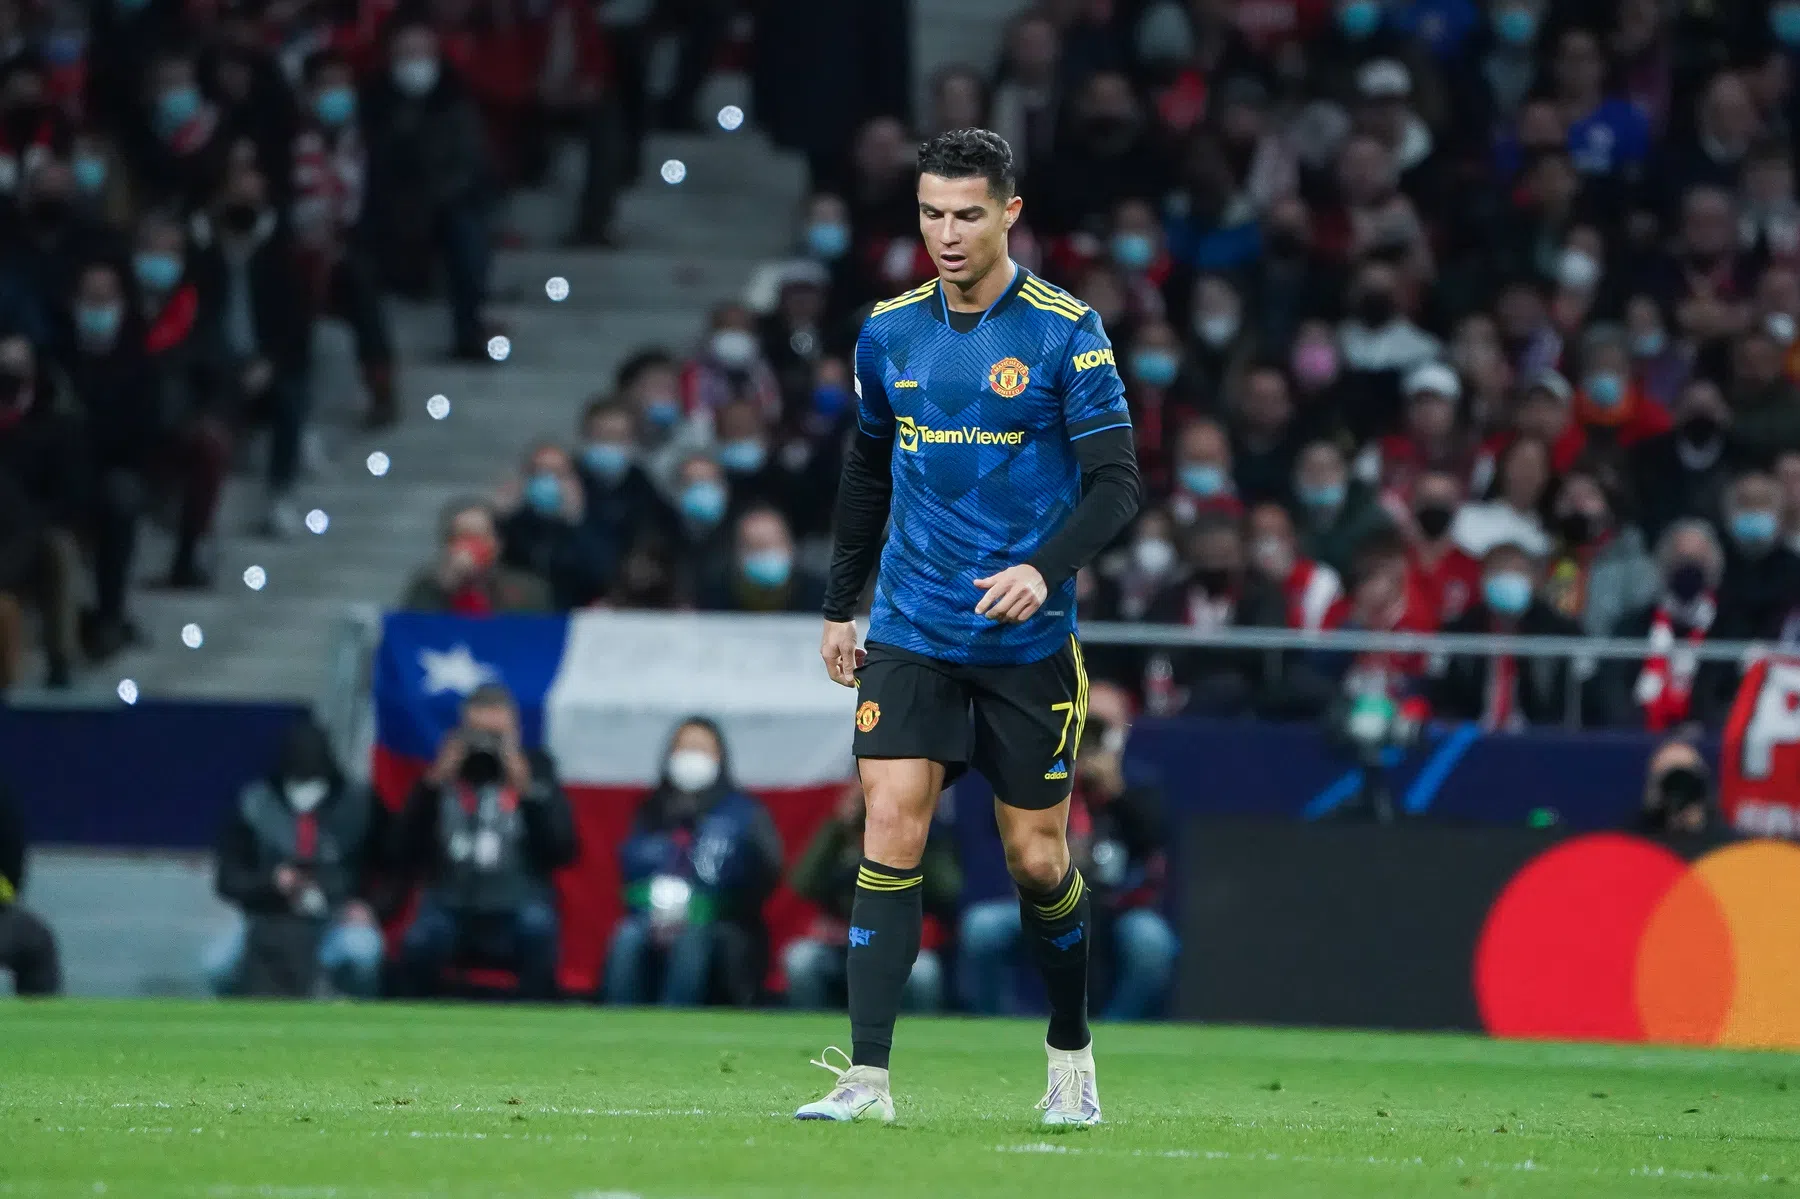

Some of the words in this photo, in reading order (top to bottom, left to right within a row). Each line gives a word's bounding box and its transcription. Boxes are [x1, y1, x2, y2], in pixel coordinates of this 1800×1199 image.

[994, 360, 1026, 375] MANCHESTER
[894, 379, 918, 389] adidas
[917, 426, 1024, 445] TeamViewer
[1051, 701, 1074, 758] 7
